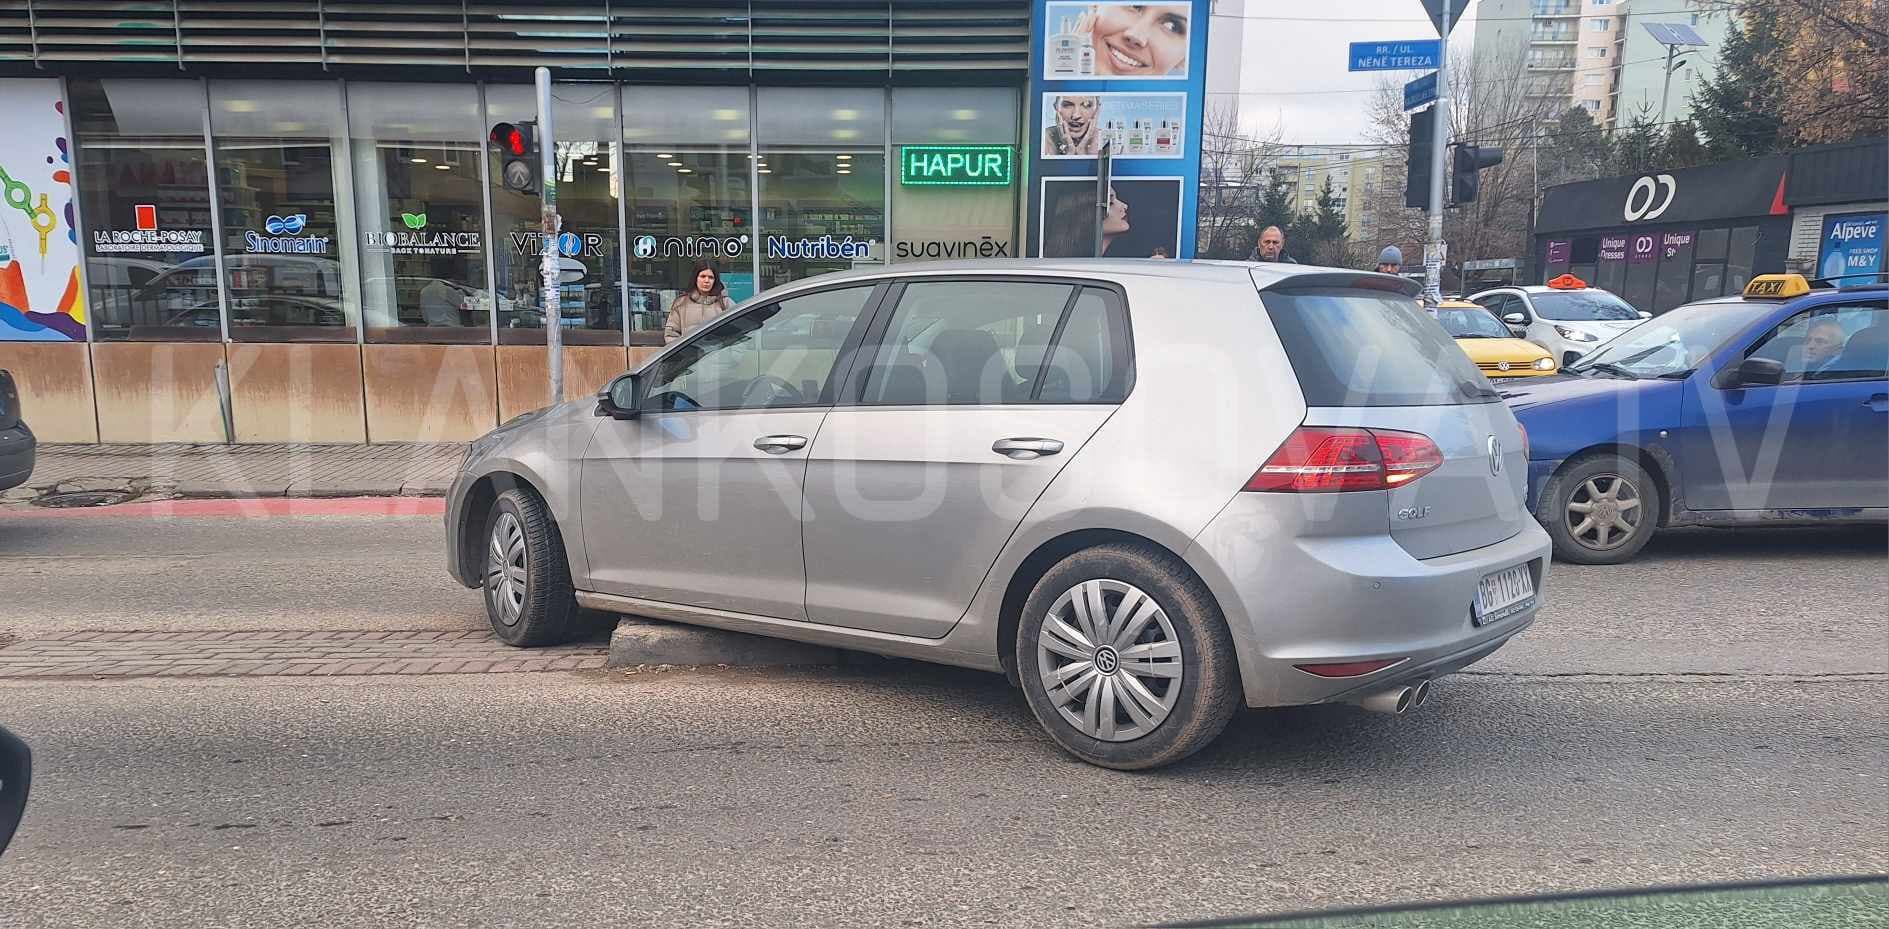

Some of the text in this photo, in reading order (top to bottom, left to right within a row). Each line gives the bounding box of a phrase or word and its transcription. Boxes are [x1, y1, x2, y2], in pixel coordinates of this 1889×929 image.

[1391, 56, 1431, 67] TEREZA
[910, 153, 1002, 177] HAPUR
[94, 230, 202, 243] LA ROCHE-POSAY
[365, 232, 480, 247] BIOBALANCE
[1664, 234, 1690, 246] Unique
[95, 244, 204, 252] LABORATOIRE DERMATOLOGIQUE
[1603, 238, 1625, 250] Unique
[1751, 282, 1783, 296] TAXI
[1398, 504, 1432, 520] GOLF
